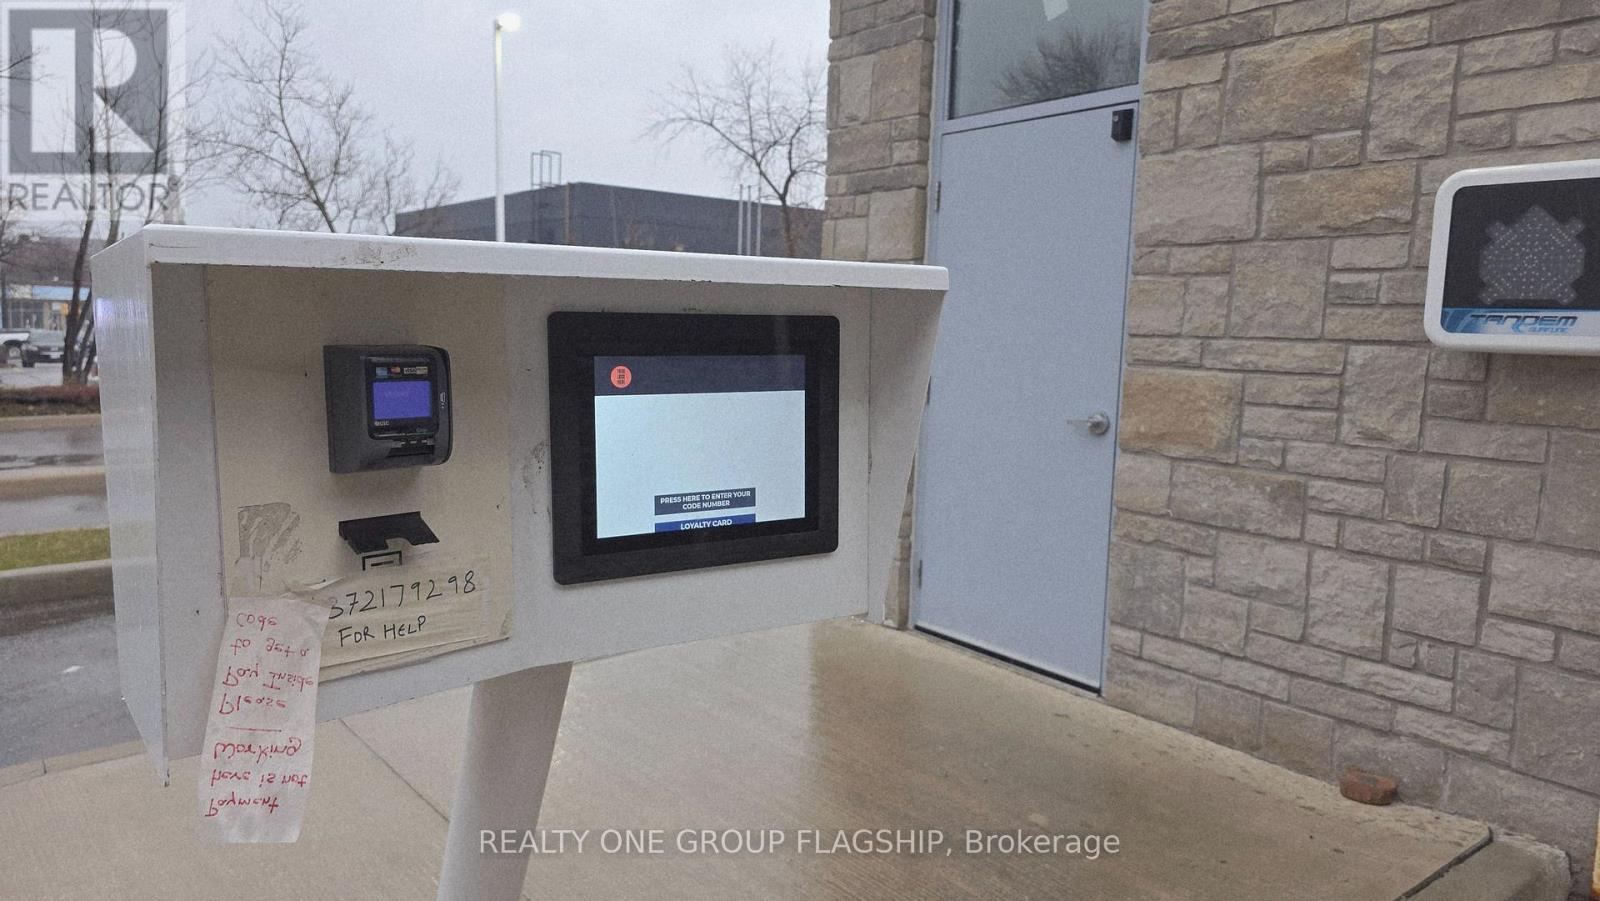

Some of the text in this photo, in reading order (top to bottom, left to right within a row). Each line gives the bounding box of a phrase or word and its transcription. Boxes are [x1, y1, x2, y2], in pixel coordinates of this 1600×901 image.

[1470, 314, 1579, 327] TANDEM
[680, 519, 732, 530] LOYALTY CARD
[338, 615, 427, 648] FOR HELP
